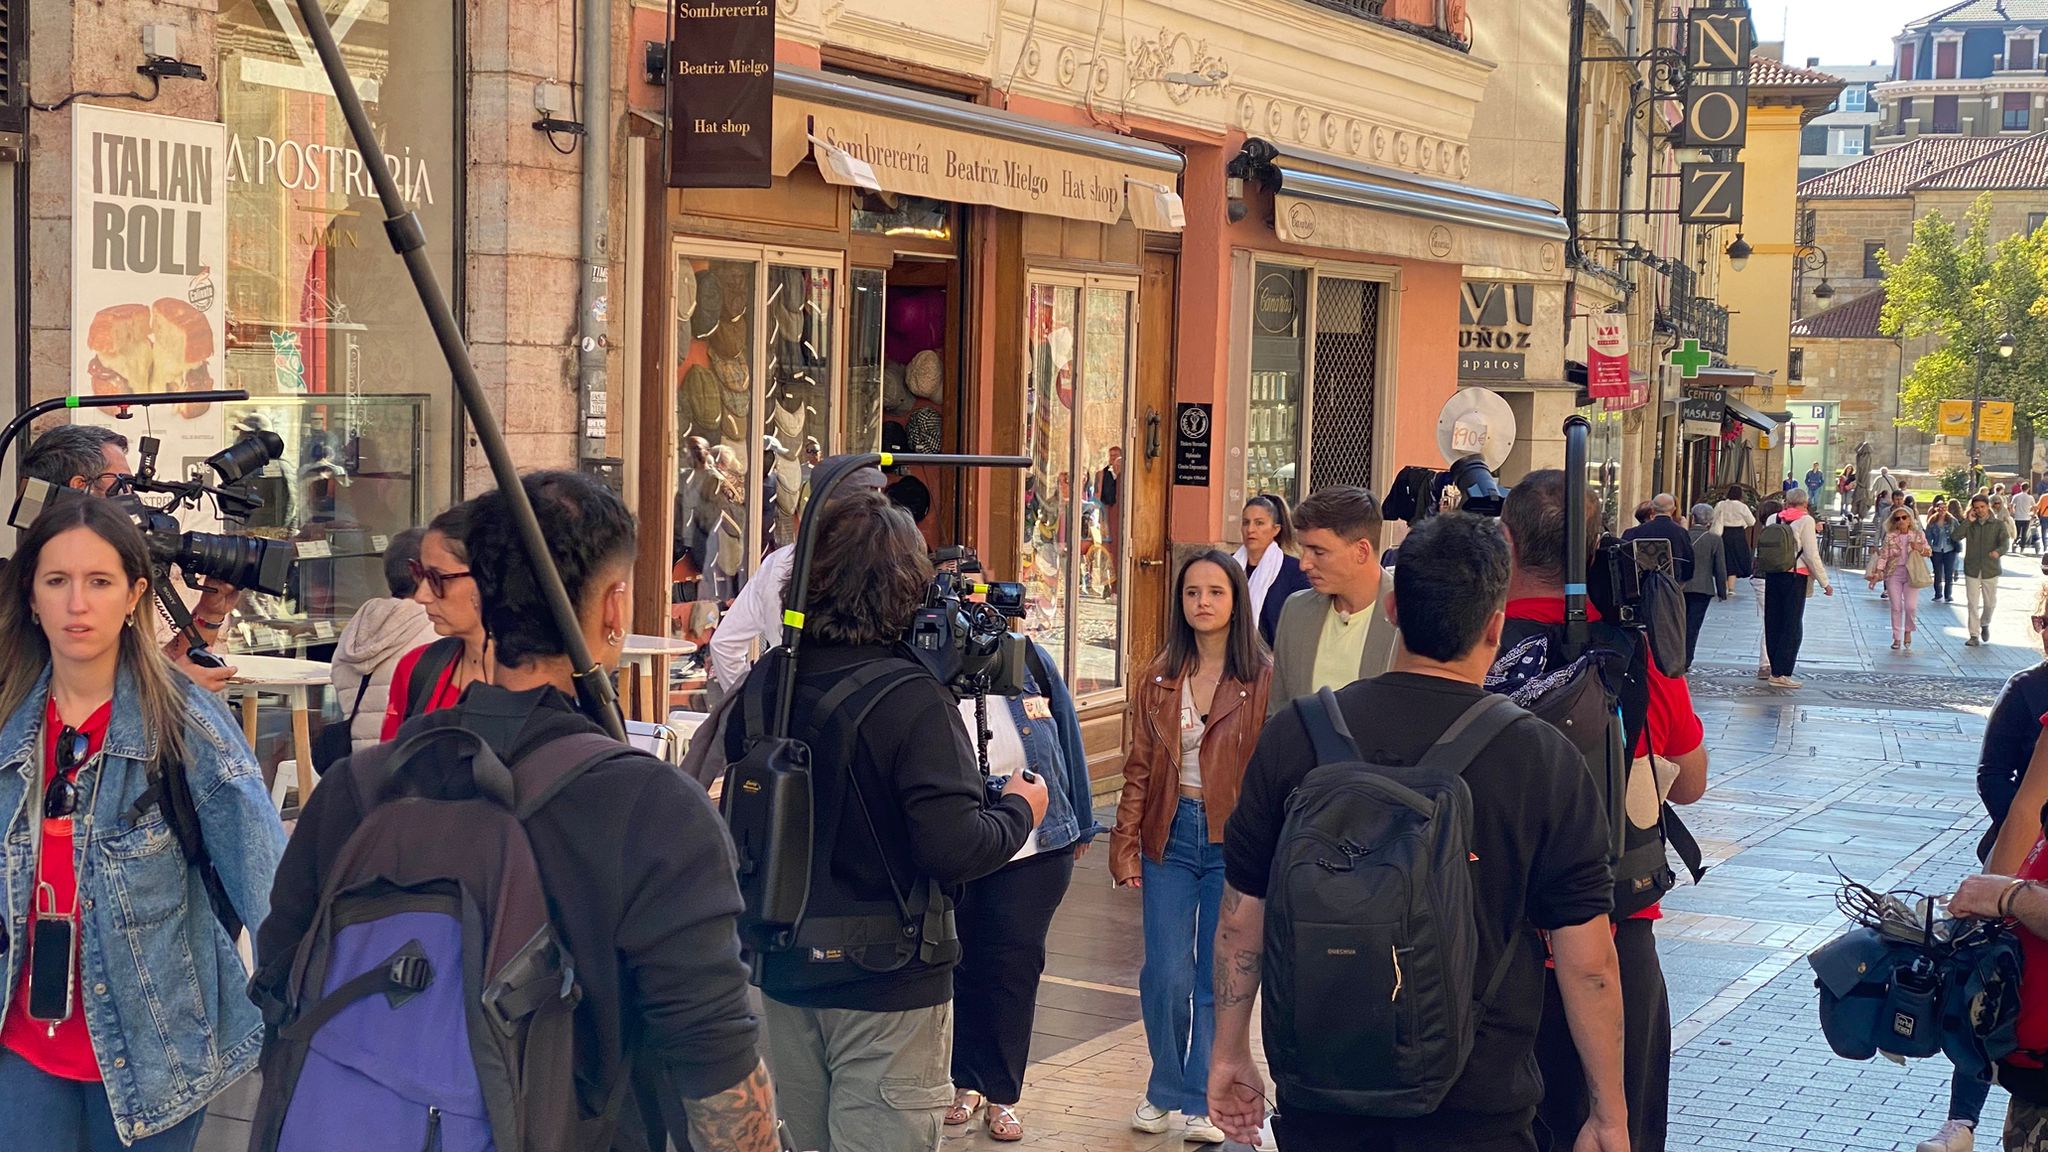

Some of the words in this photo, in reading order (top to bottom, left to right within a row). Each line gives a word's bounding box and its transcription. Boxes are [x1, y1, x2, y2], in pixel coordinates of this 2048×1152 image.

[680, 1, 768, 18] Sombrerería
[679, 61, 725, 75] Beatriz
[728, 60, 769, 77] Mielgo
[695, 119, 718, 133] Hat
[721, 119, 750, 136] shop
[226, 133, 250, 183] A
[92, 132, 212, 205] ITALIAN
[826, 127, 929, 175] Sombrerería
[945, 149, 999, 185] Beatriz
[1003, 160, 1048, 200] Mielgo
[1062, 169, 1086, 200] Hat
[1089, 175, 1118, 212] shop
[92, 201, 210, 276] ROLL
[1459, 327, 1532, 349] U-ÑOZ
[1462, 357, 1520, 372] apatos
[1688, 390, 1722, 401] CENTRO
[1683, 408, 1721, 420] MASAJES
